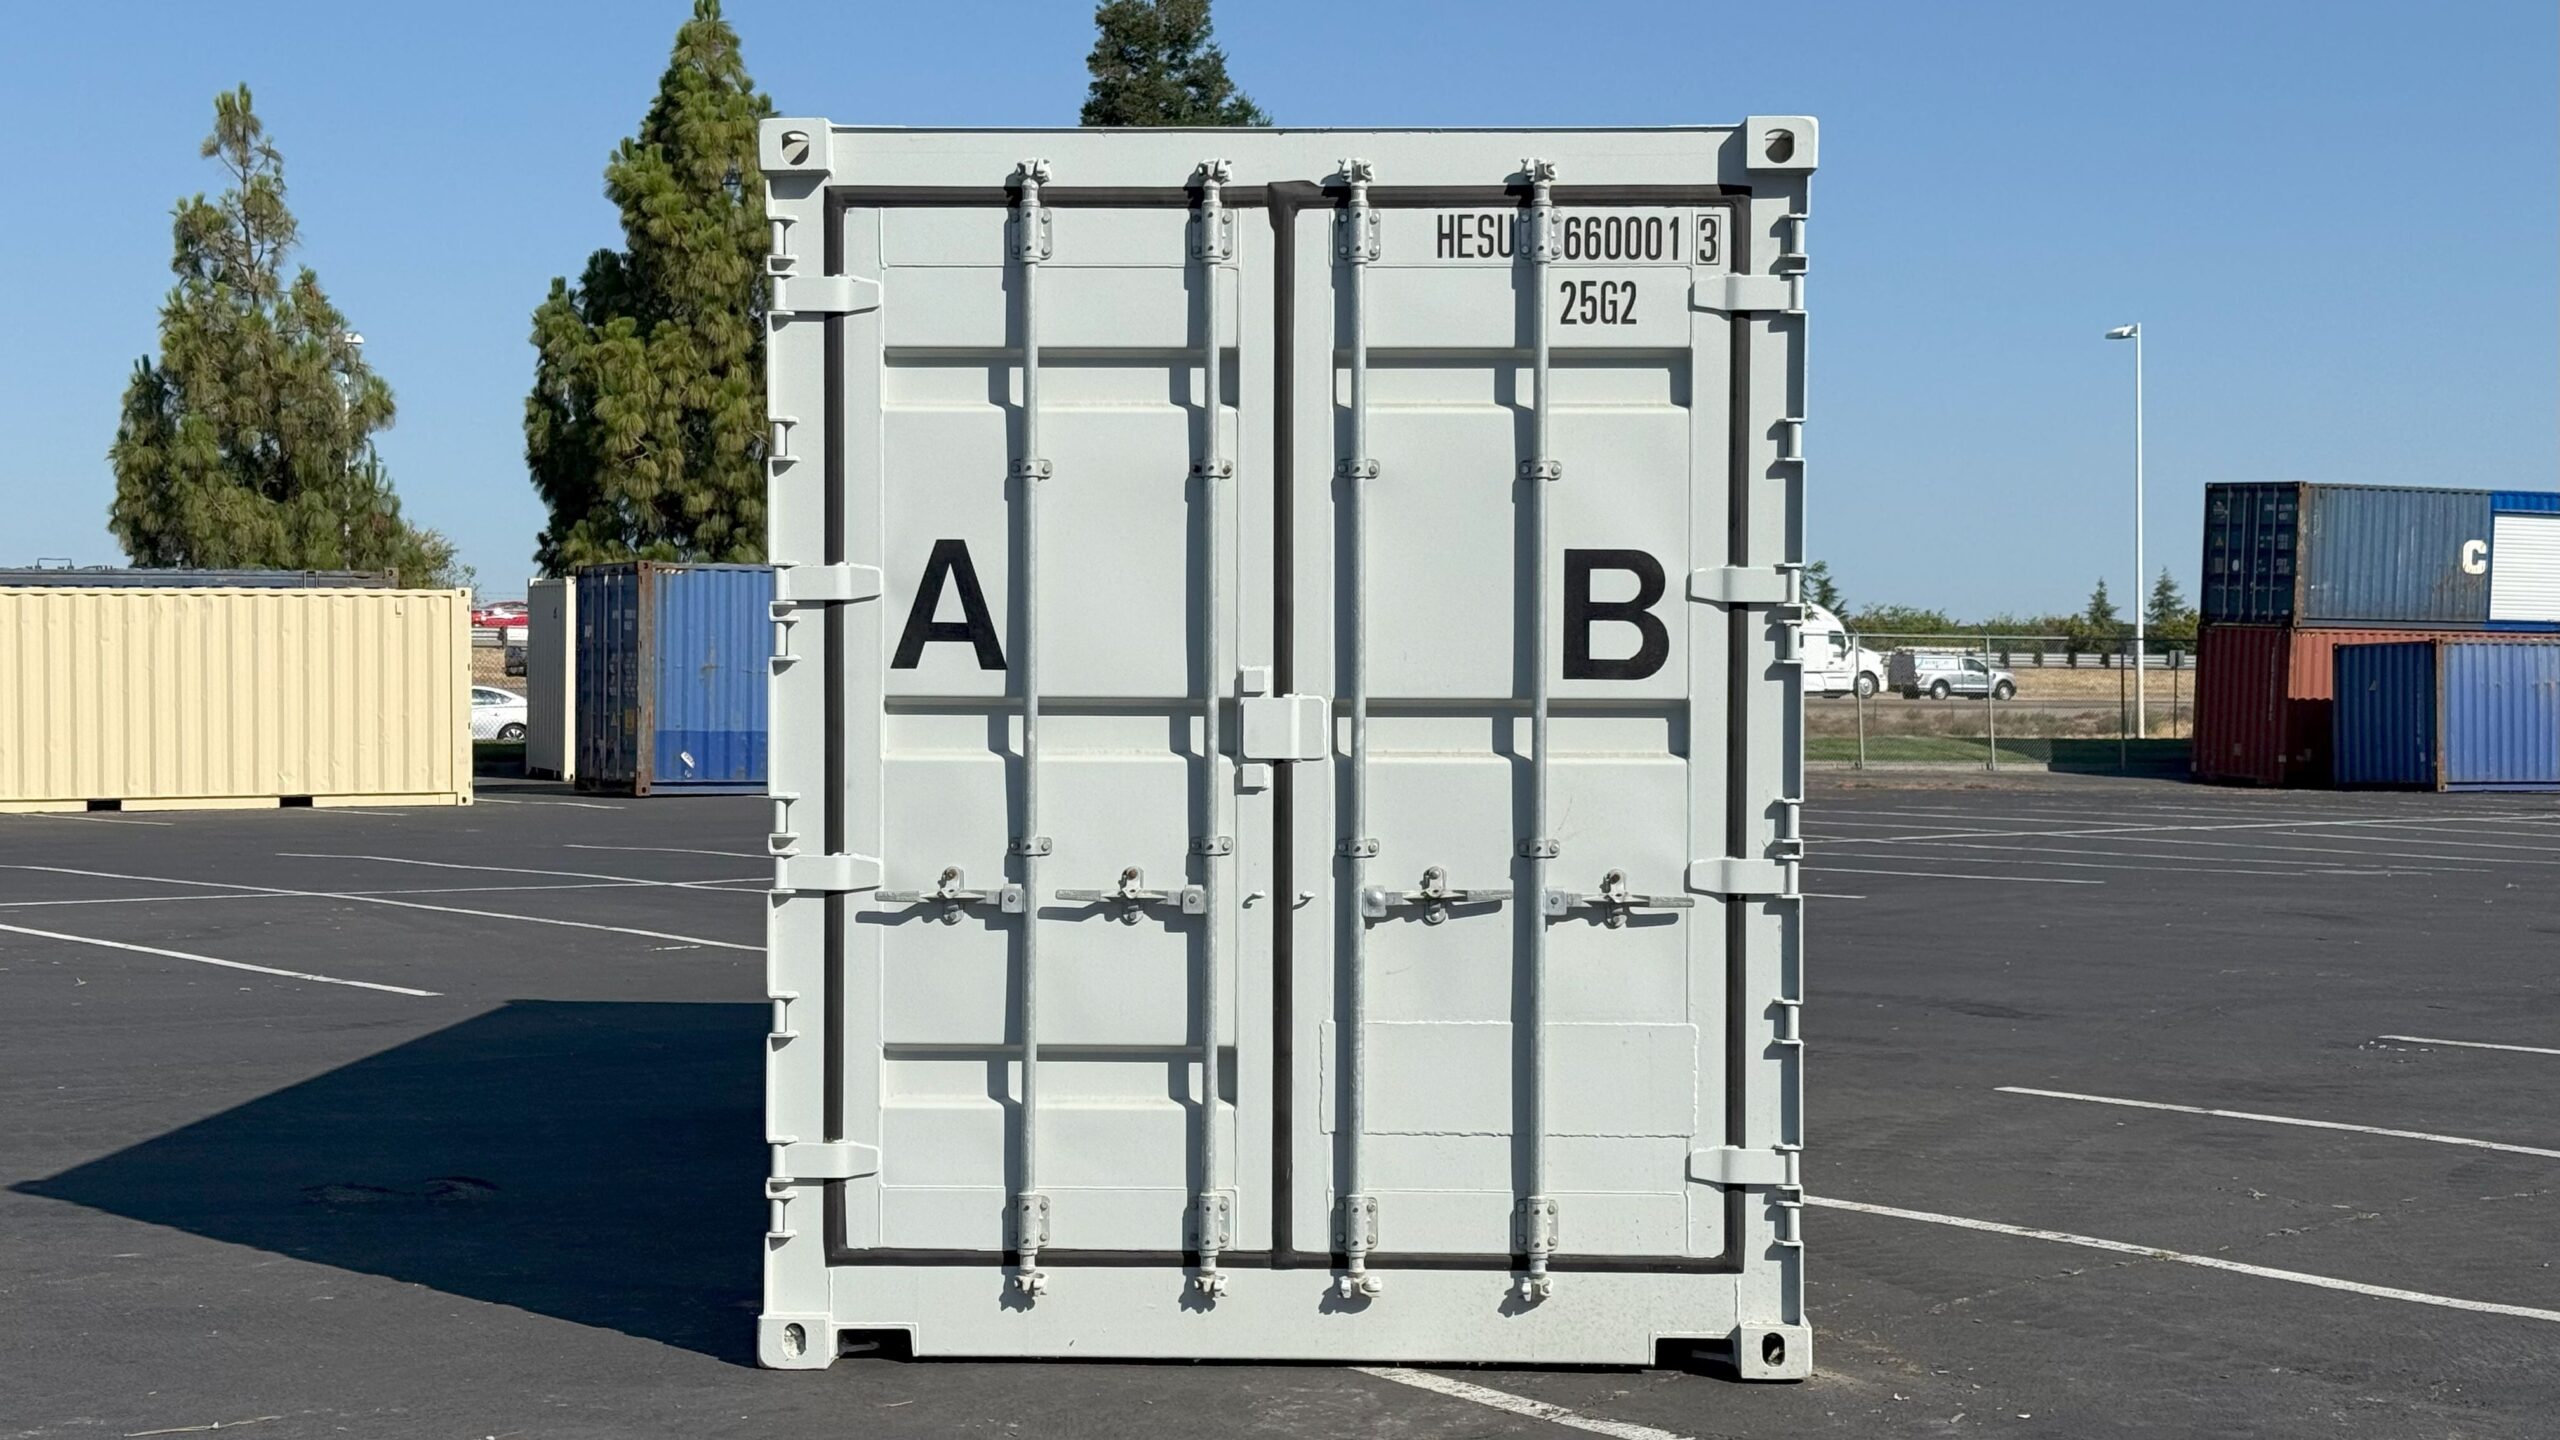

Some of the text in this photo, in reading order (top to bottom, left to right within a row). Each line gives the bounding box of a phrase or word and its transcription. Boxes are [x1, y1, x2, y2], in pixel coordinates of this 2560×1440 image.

[1437, 213, 1717, 262] HESU 660001 3
[1560, 280, 1637, 325] 25G2
[2462, 539, 2487, 575] C
[891, 539, 1008, 670] A
[1563, 549, 1670, 681] B
